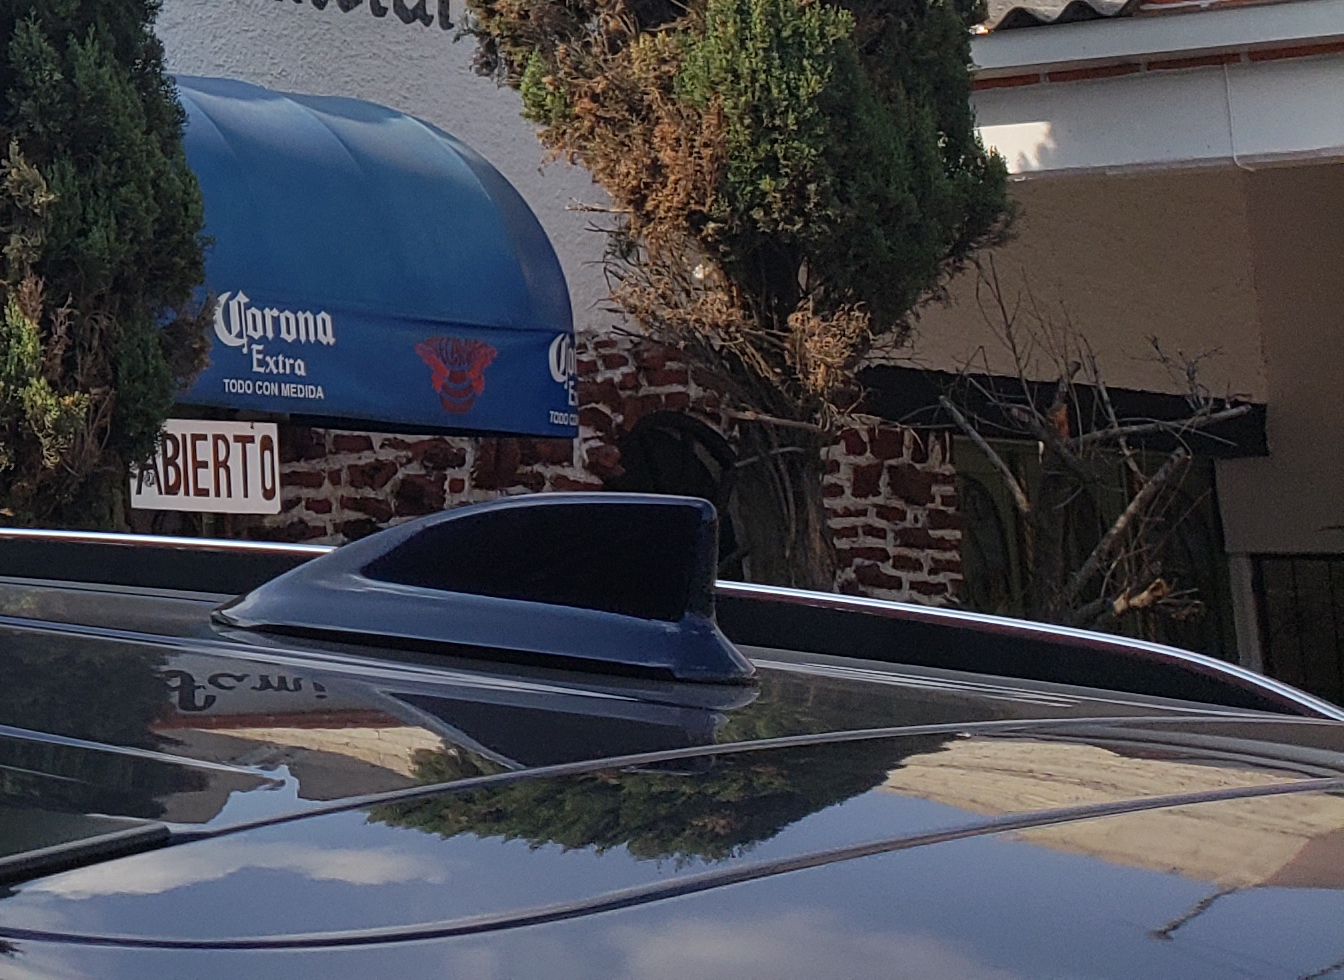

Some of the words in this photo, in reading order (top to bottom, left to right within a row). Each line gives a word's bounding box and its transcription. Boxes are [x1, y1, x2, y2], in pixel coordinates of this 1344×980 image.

[212, 290, 336, 354] Corona
[251, 343, 306, 376] Extra
[223, 378, 253, 395] TODO
[255, 381, 279, 396] CON
[280, 383, 325, 399] MEDIDA
[135, 433, 276, 501] ABIERTO
